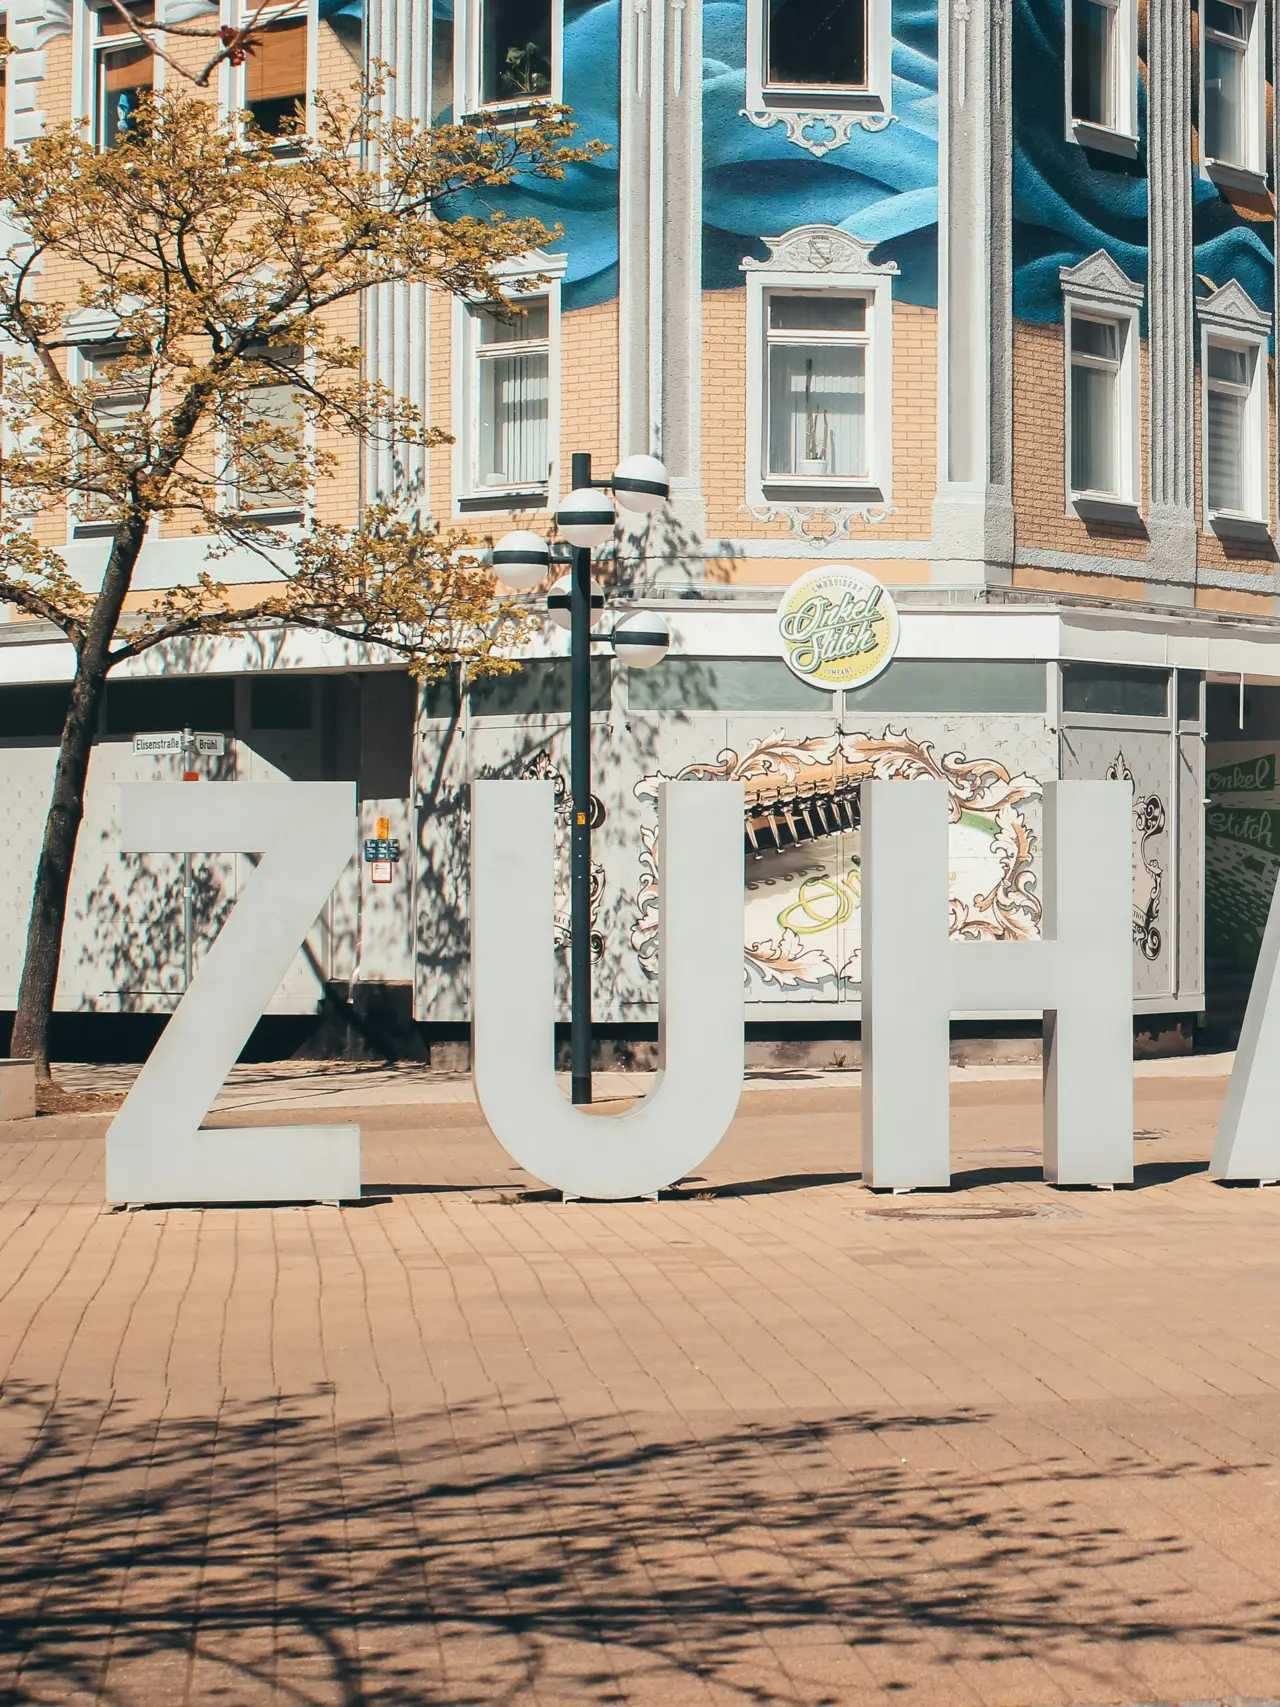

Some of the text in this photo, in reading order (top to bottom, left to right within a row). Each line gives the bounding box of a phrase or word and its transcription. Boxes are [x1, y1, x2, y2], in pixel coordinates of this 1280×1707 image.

[779, 585, 884, 642] Onkel
[790, 619, 879, 674] Stitch
[136, 738, 180, 750] Elisenstraße
[199, 739, 218, 750] Brühl
